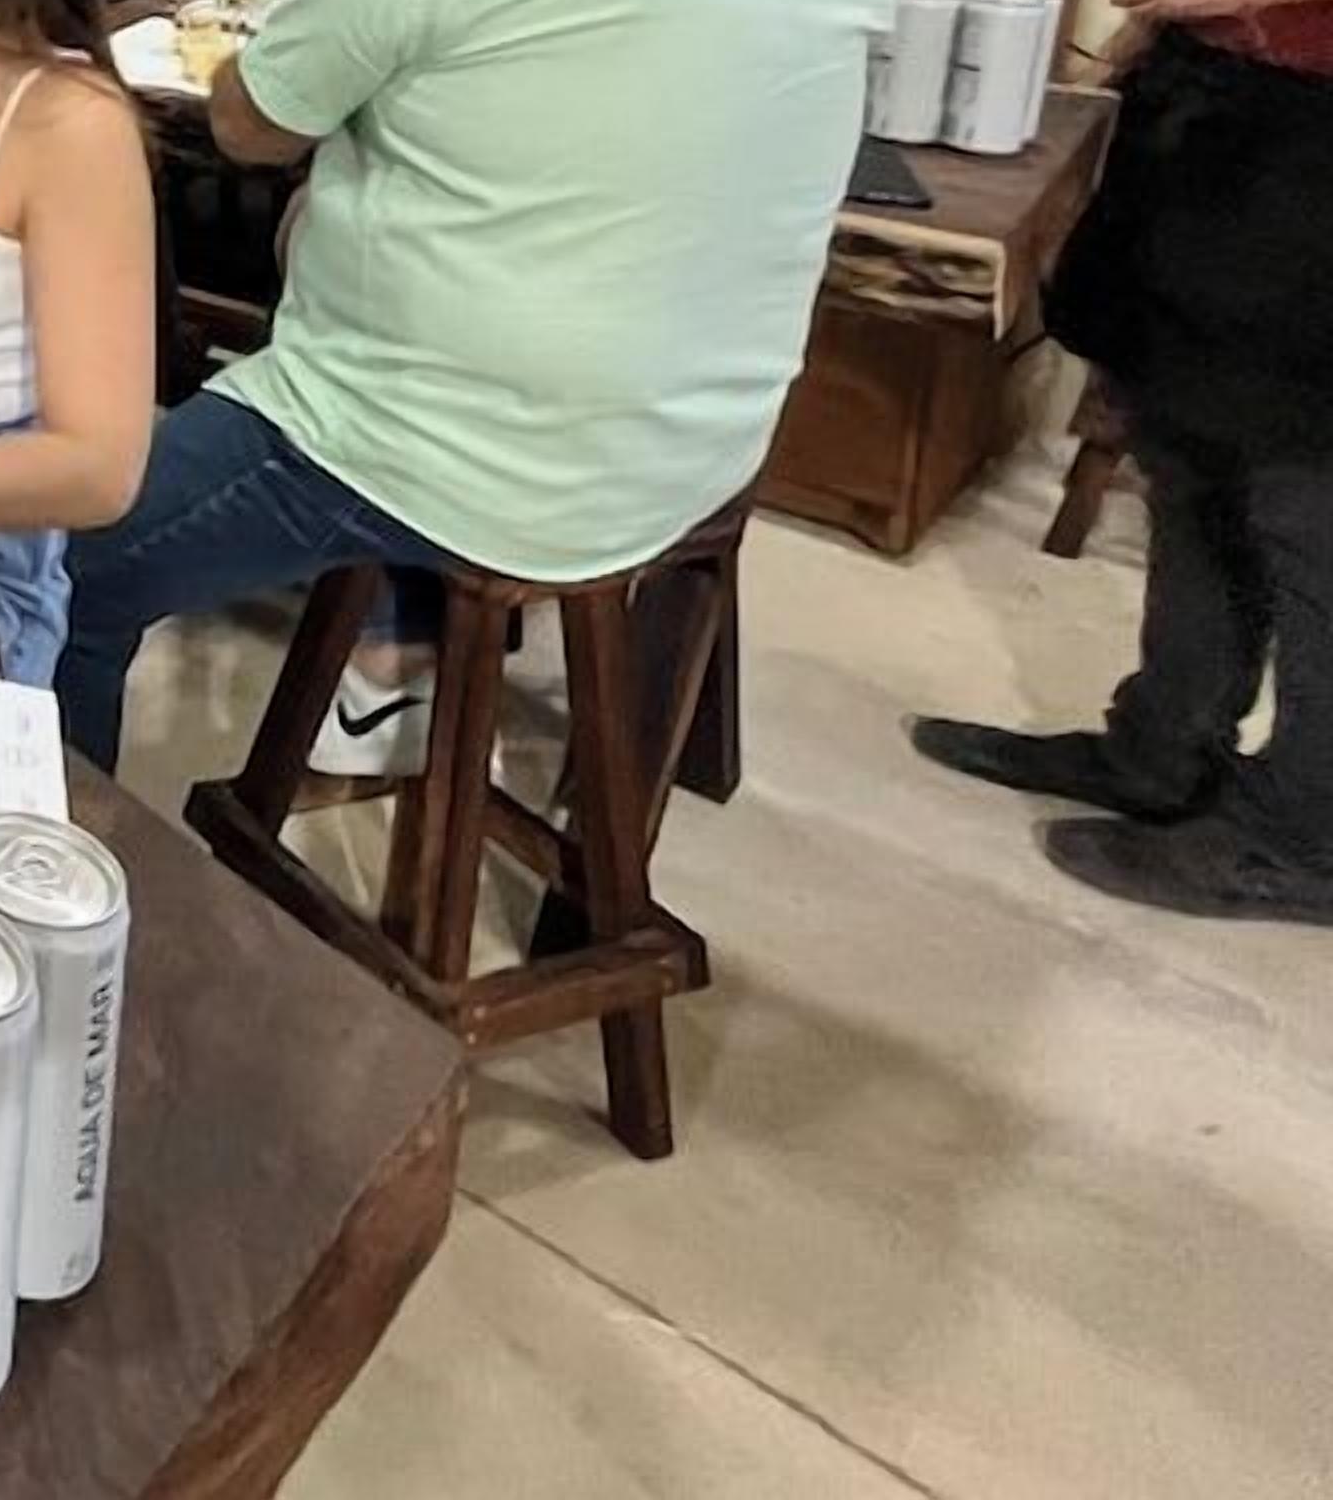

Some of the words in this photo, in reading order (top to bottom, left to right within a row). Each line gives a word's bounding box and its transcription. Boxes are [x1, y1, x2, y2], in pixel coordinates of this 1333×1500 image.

[86, 982, 113, 1058] MAR
[82, 1069, 106, 1109] DE
[74, 1112, 103, 1203] AGUA
